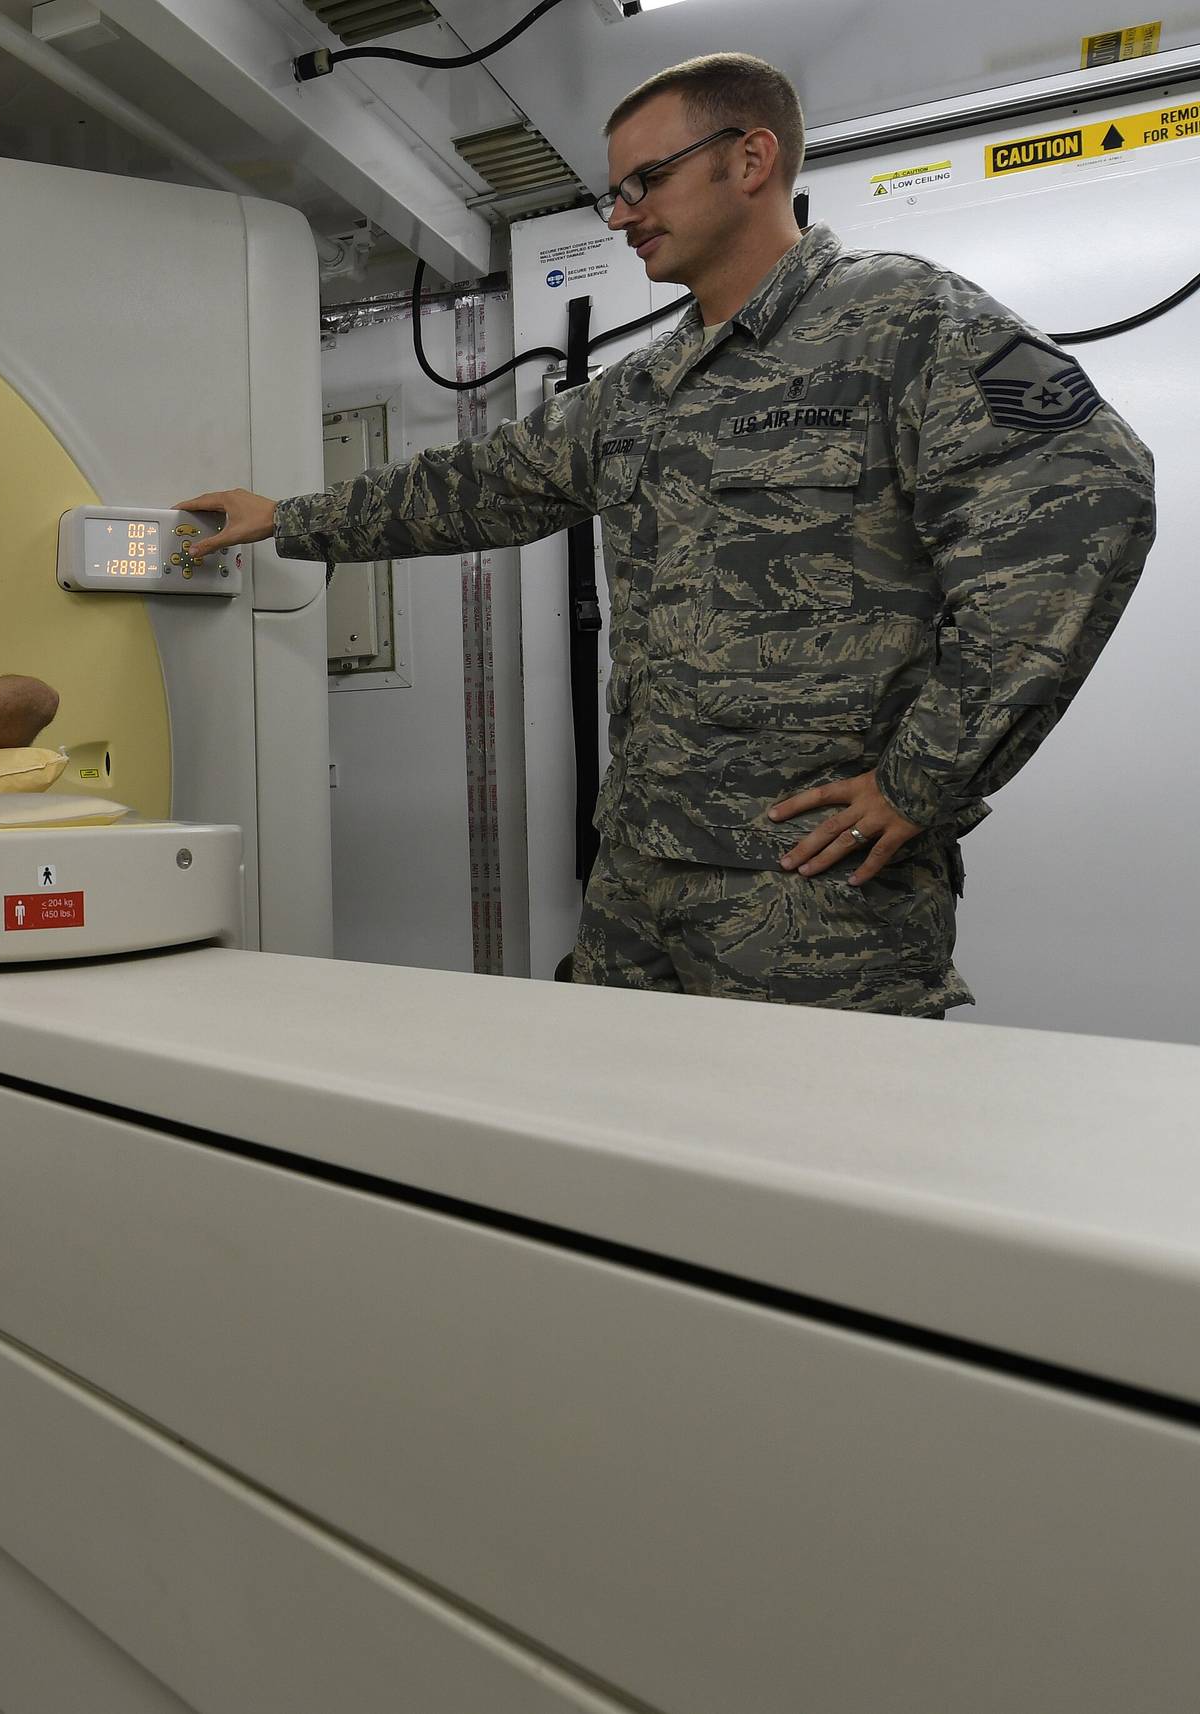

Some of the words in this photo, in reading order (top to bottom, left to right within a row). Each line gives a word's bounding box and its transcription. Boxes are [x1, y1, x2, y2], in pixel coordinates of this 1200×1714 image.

[1161, 106, 1200, 125] REMO
[1144, 128, 1168, 144] FOR
[1176, 121, 1200, 137] SHI
[996, 135, 1079, 168] CAUTION
[902, 167, 929, 177] CAUTION
[893, 180, 913, 190] LOW
[915, 172, 951, 185] CEILING
[763, 410, 790, 429] AIR
[794, 408, 853, 427] FORCE
[128, 523, 145, 539] 0.0
[128, 541, 145, 557] 85
[106, 559, 146, 576] 1289.8
[48, 899, 62, 908] 204
[41, 911, 59, 920] (450
[60, 909, 76, 919] lbs.)
